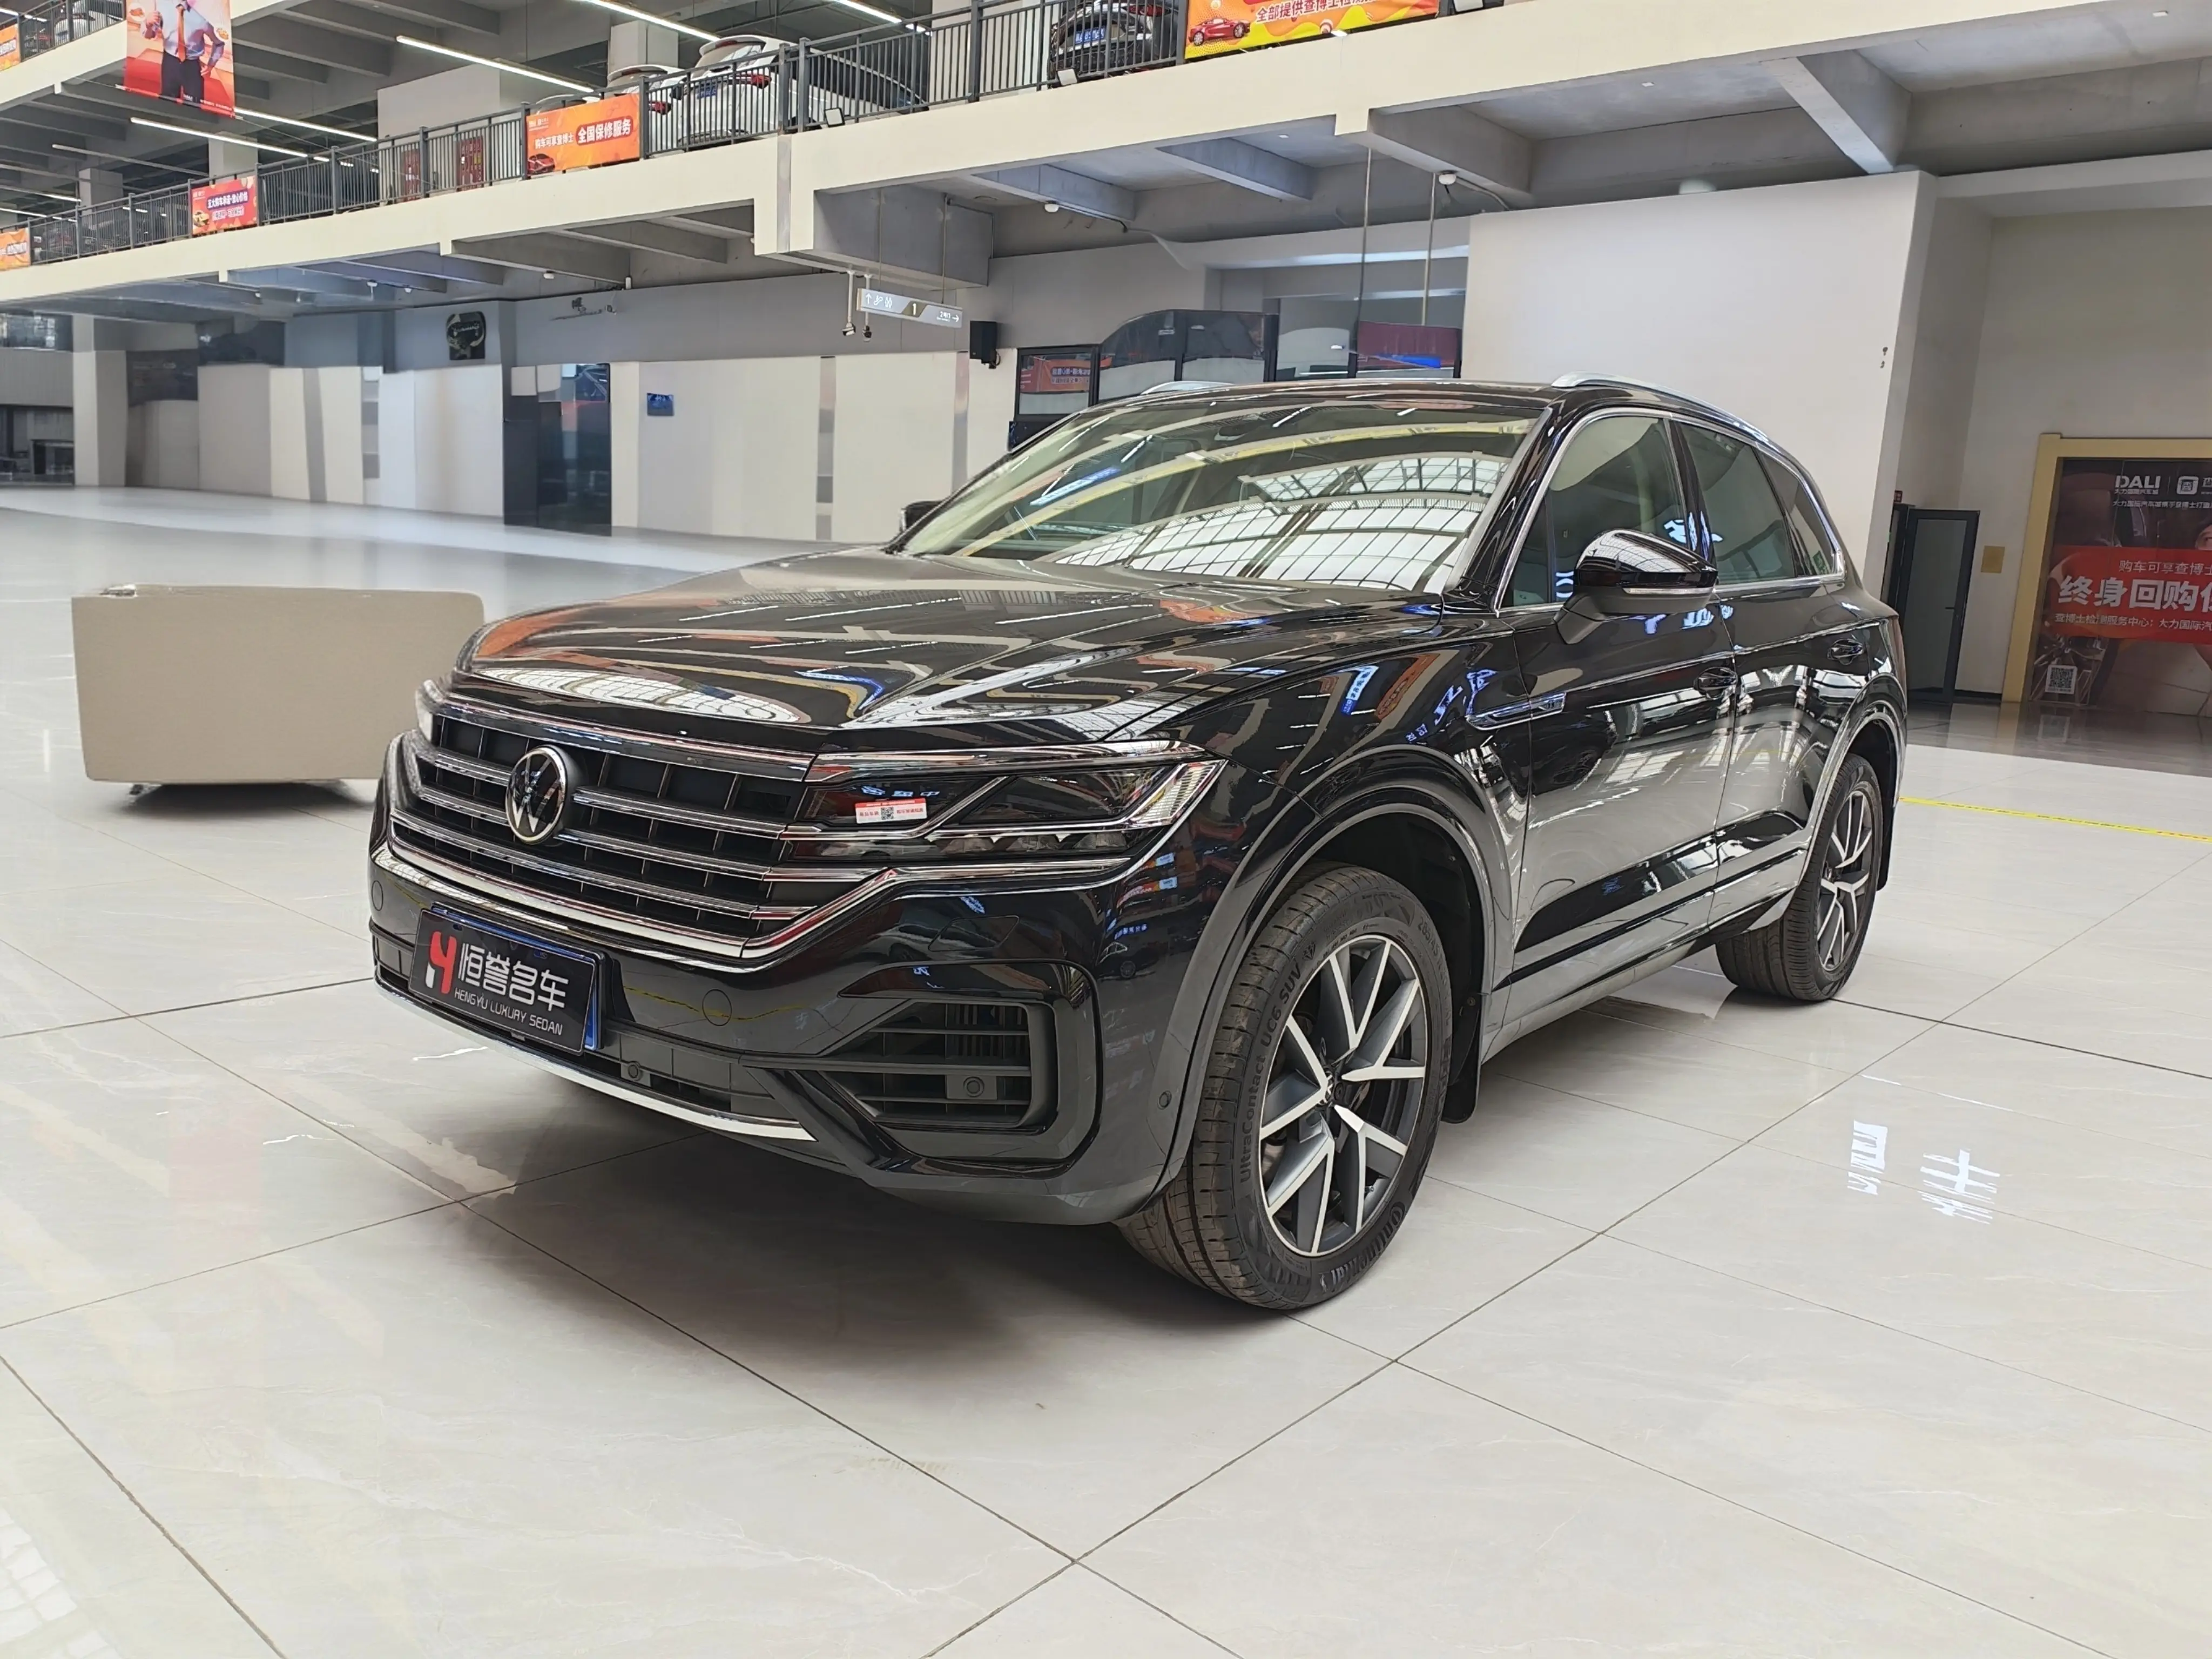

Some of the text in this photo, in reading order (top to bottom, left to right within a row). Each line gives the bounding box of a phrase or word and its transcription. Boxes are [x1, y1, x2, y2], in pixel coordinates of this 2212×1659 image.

[577, 118, 631, 144] 全国保修服务
[912, 303, 917, 315] 1
[2115, 475, 2161, 489] DALI
[458, 942, 569, 1011] 恒誉名车
[454, 987, 489, 1010] HENGYU
[529, 1014, 563, 1036] SEDAN
[1240, 963, 1303, 1183] UltraContact UC6 SUV
